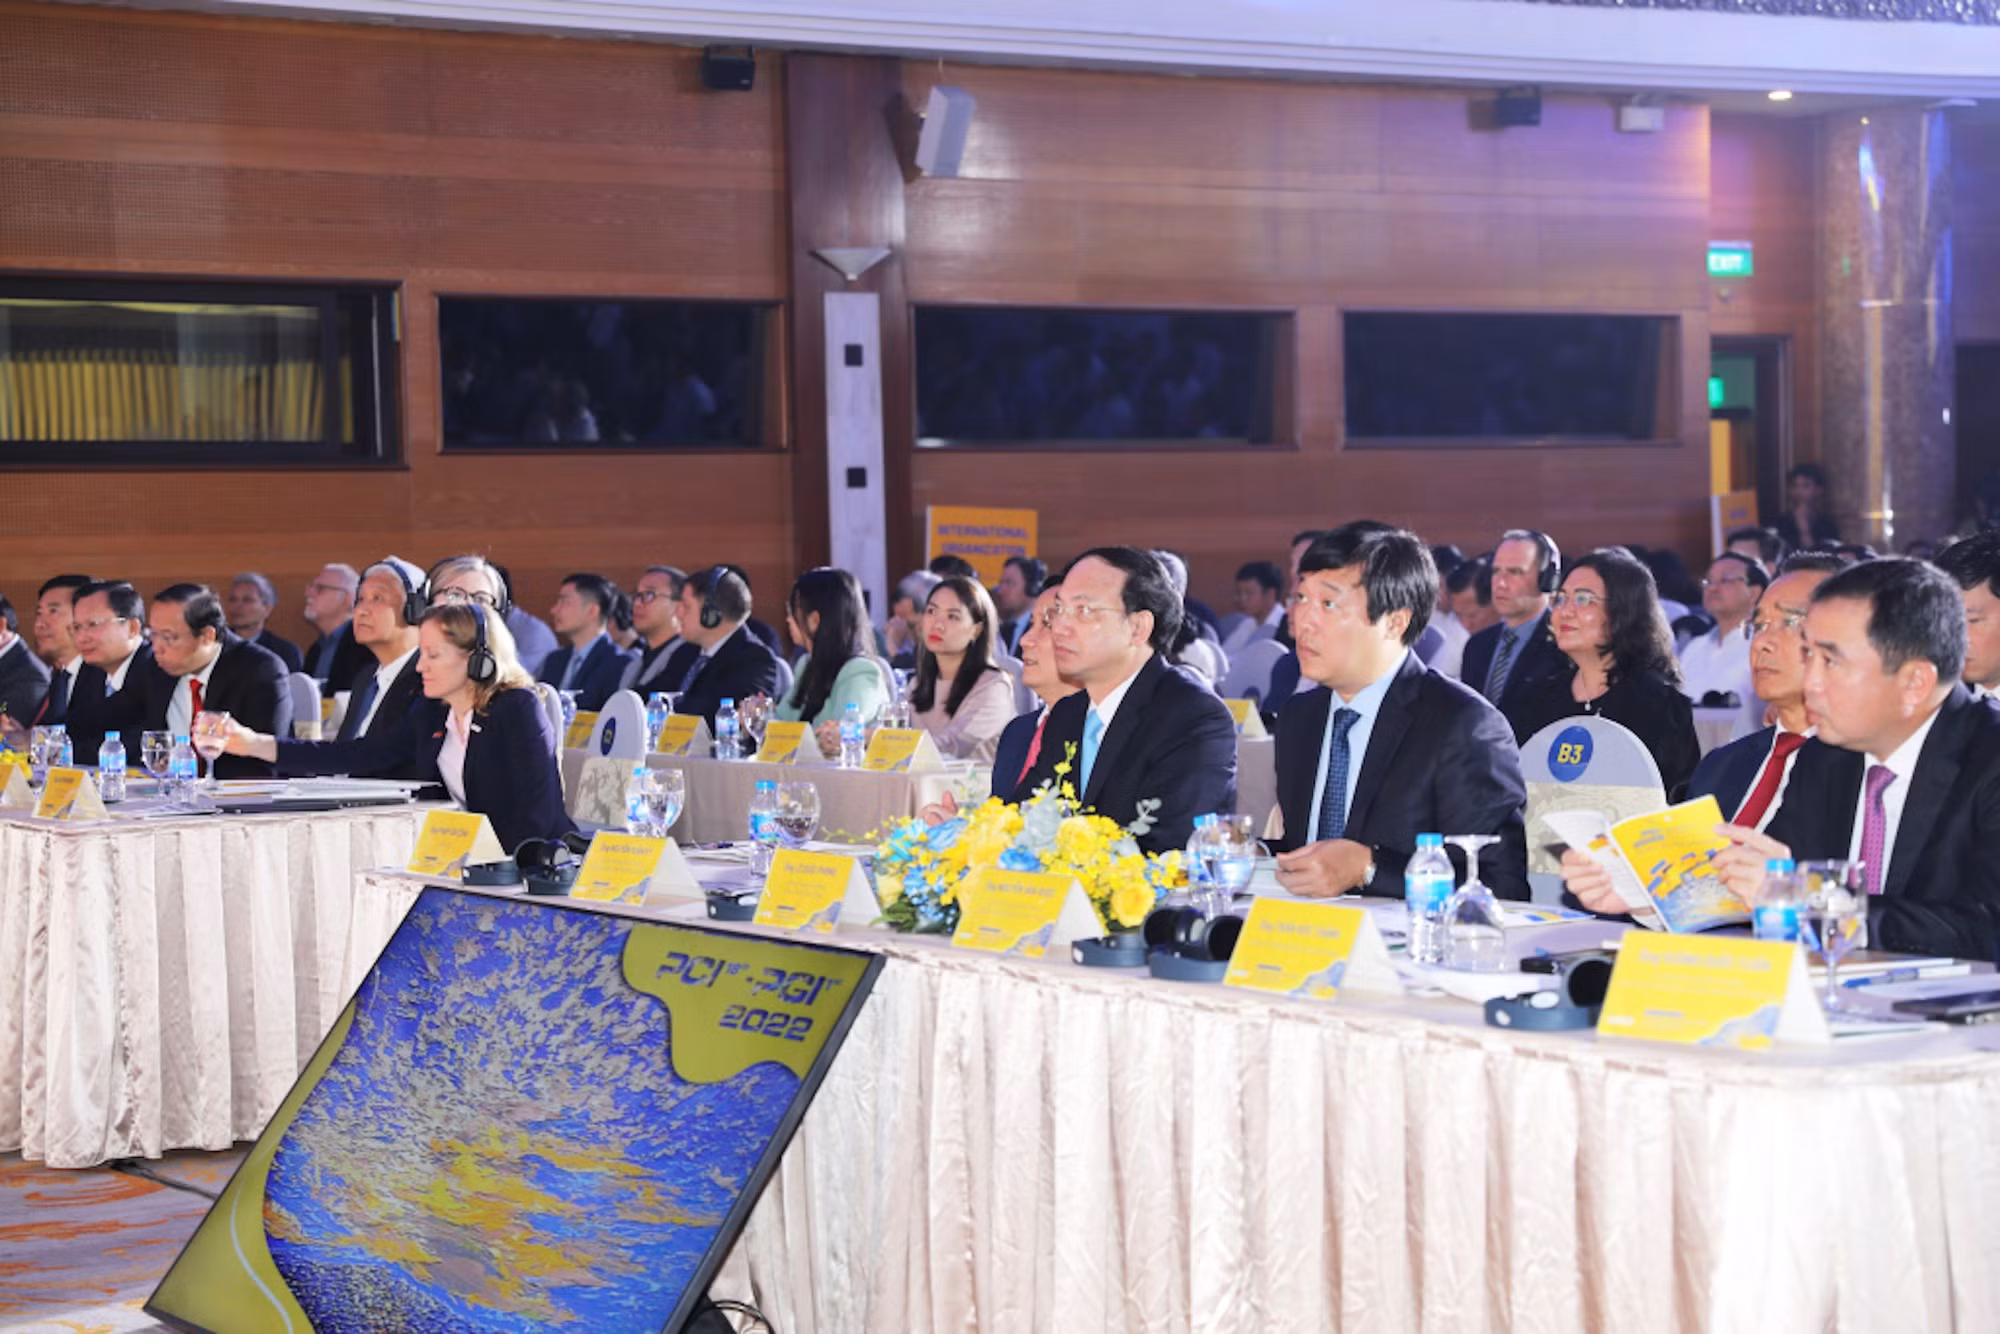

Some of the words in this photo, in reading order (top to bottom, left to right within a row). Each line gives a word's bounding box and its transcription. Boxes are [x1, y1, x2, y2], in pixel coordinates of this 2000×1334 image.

[1709, 254, 1742, 271] EXIT
[938, 525, 1027, 539] INTERNATIONAL
[1557, 742, 1585, 765] B3
[655, 951, 726, 988] PCI
[751, 967, 826, 1006] PGI
[718, 1004, 814, 1042] 2022
